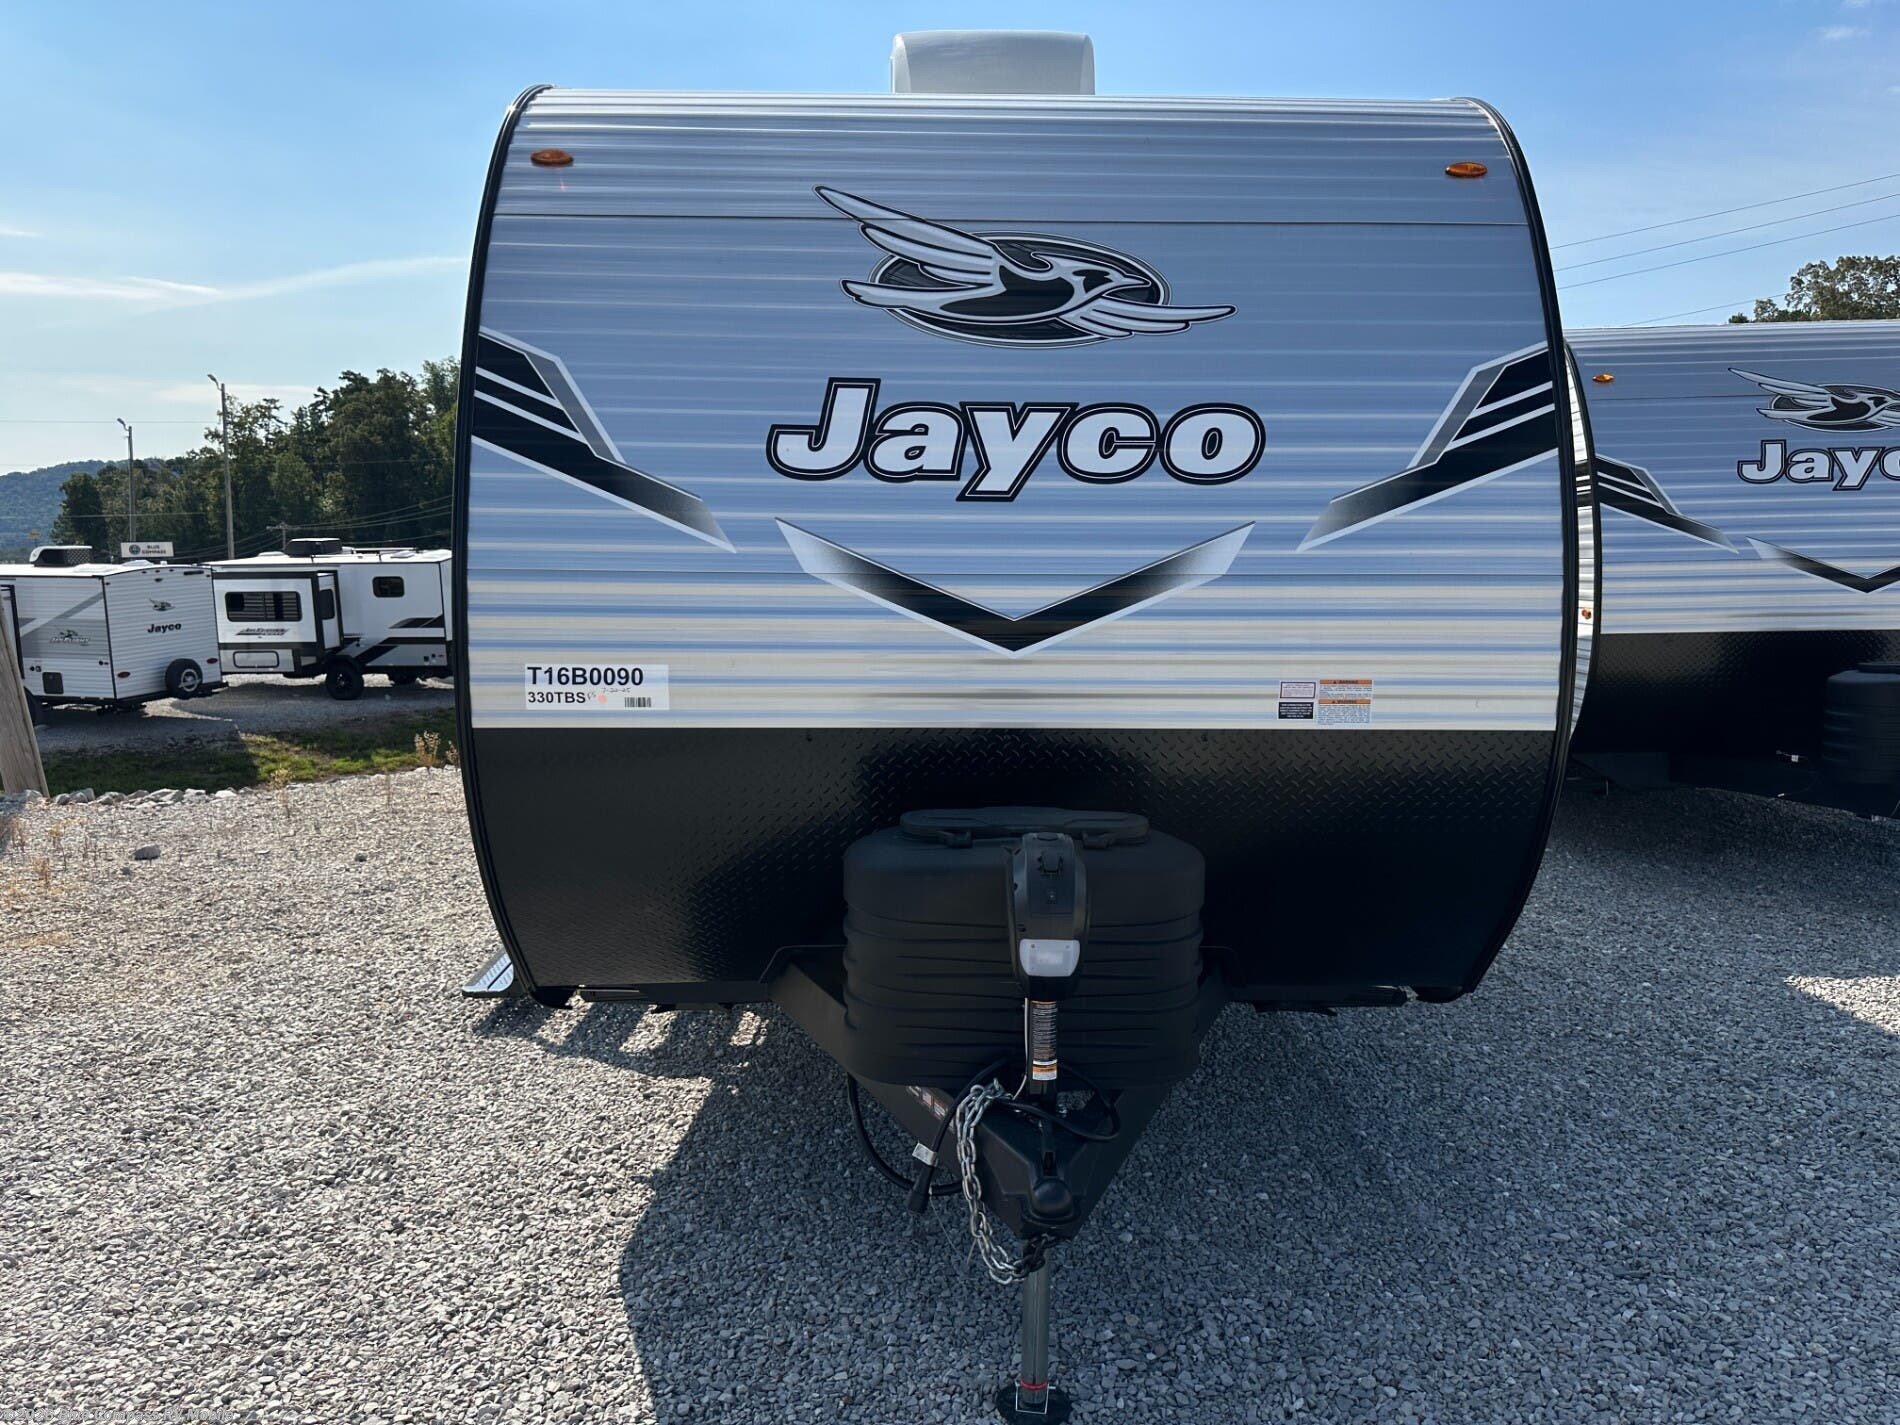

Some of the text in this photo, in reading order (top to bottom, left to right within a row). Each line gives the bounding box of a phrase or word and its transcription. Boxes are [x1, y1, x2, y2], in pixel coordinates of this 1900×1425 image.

[766, 377, 1266, 501] Jayco
[147, 623, 182, 634] Jayco
[526, 666, 644, 686] T16B0090
[527, 691, 586, 704] 330TBS
